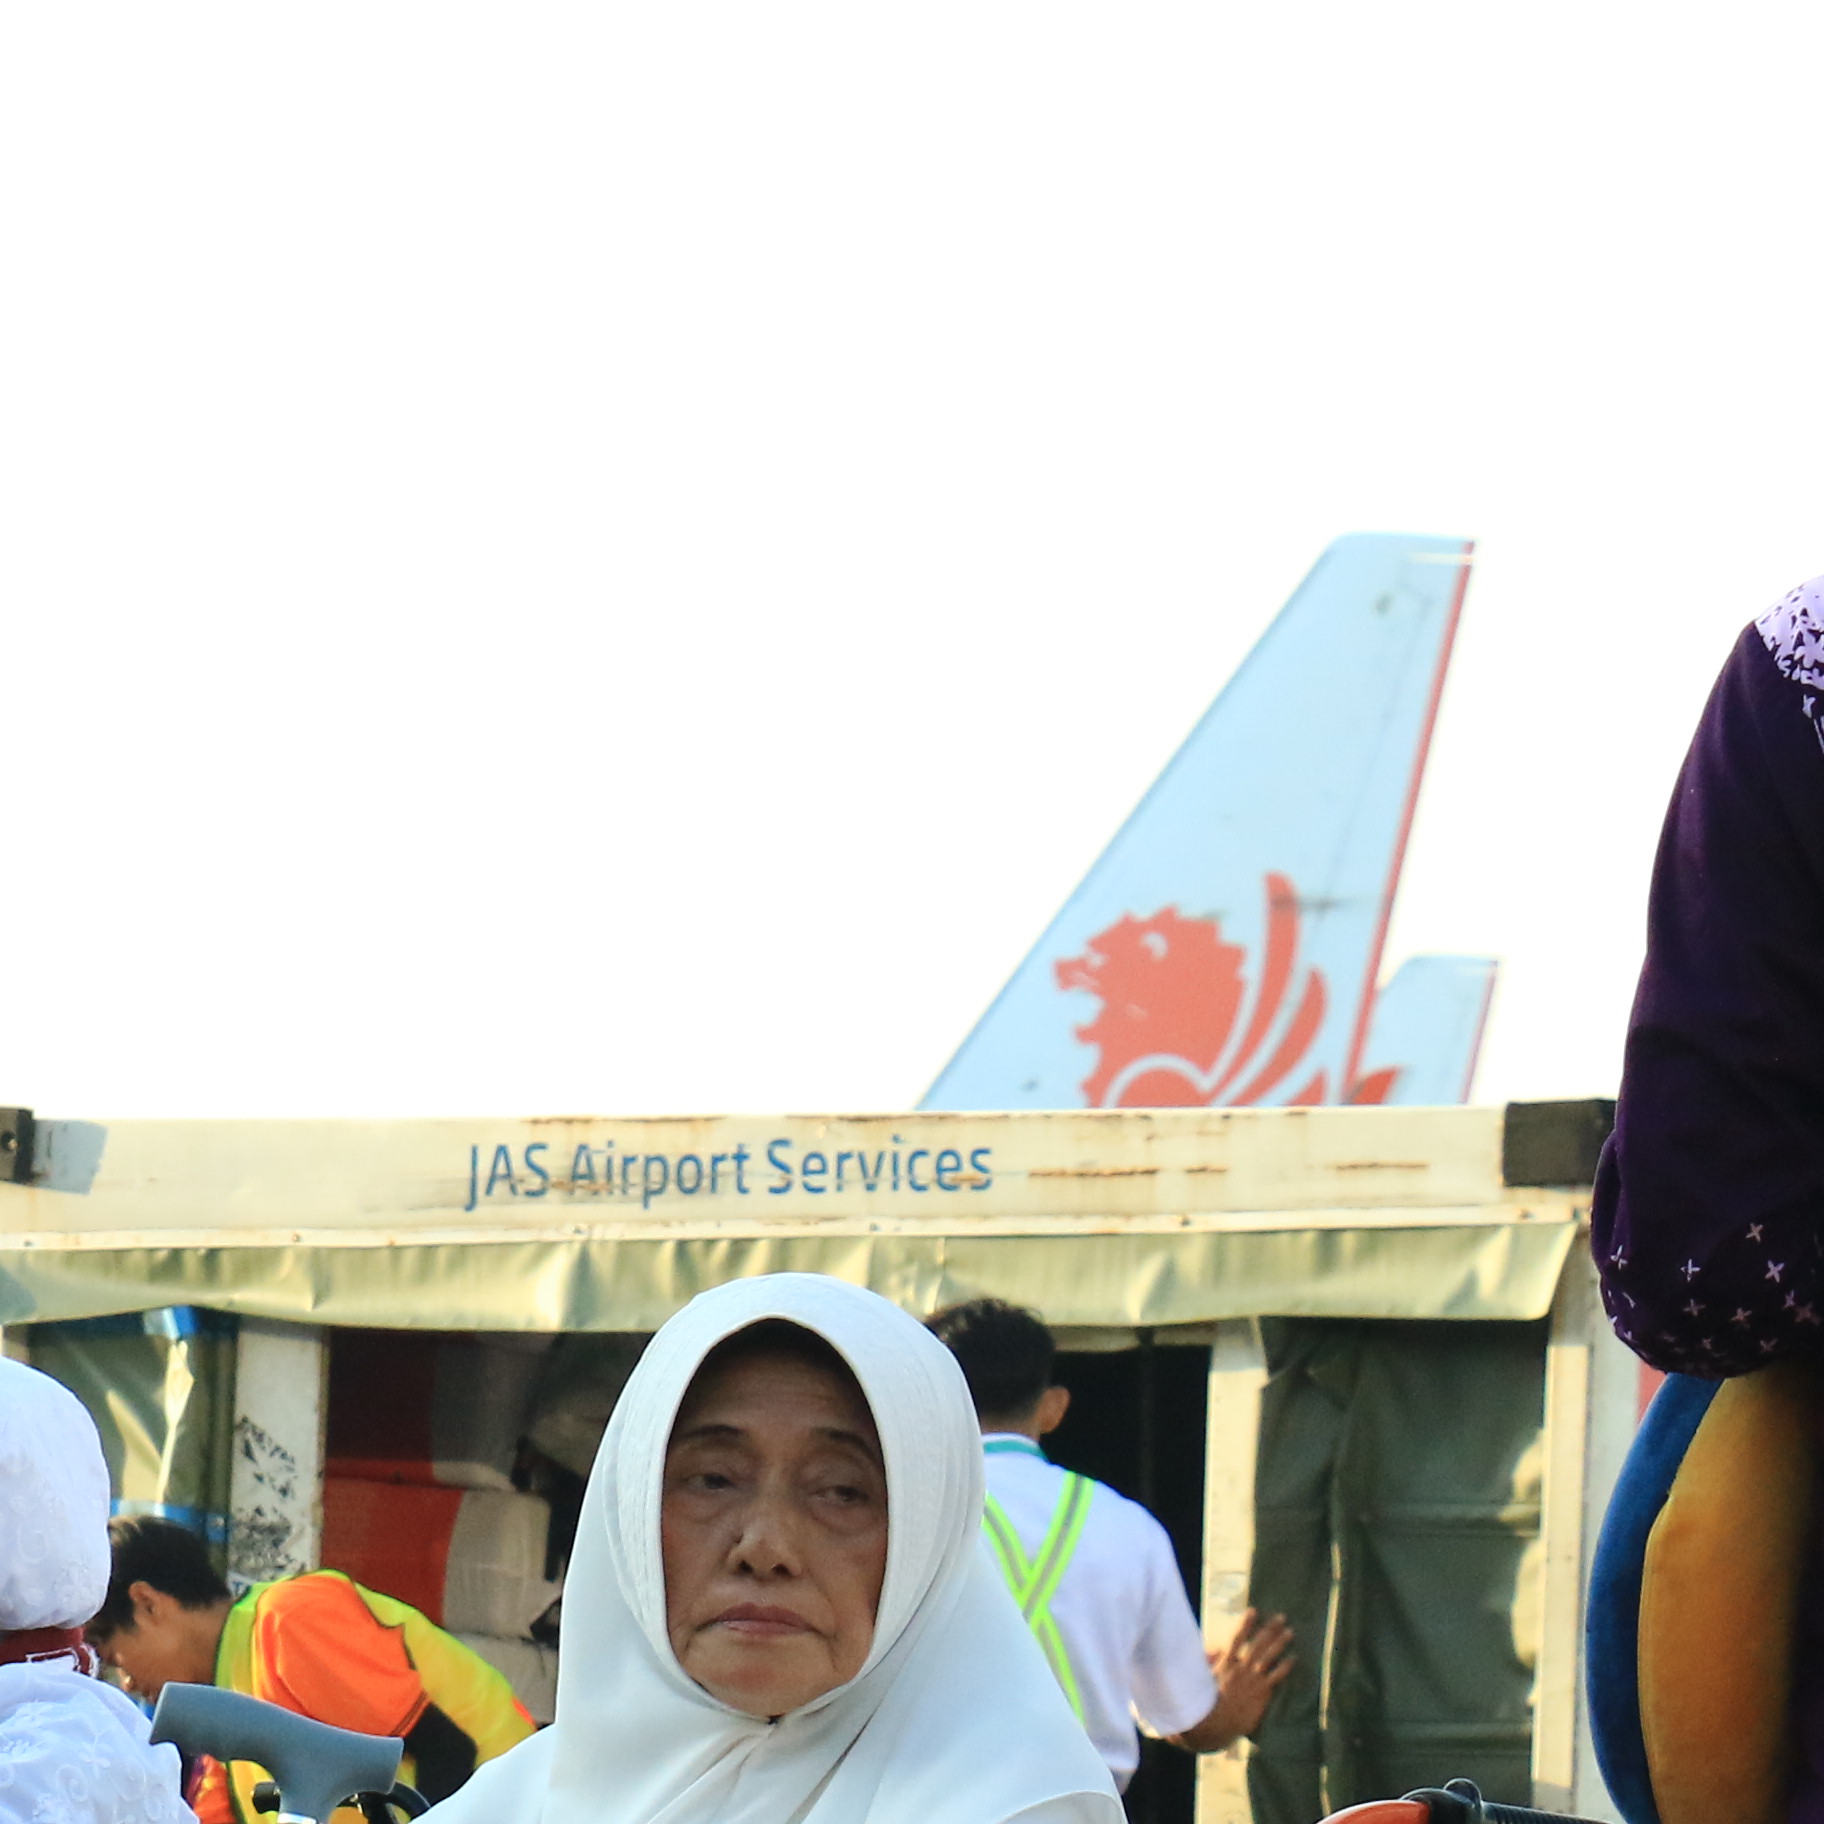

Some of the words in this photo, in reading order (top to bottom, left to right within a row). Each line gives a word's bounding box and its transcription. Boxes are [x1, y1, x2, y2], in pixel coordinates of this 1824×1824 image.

[464, 1143, 549, 1212] JAS
[569, 1141, 751, 1208] Airport
[767, 1134, 993, 1195] Services
